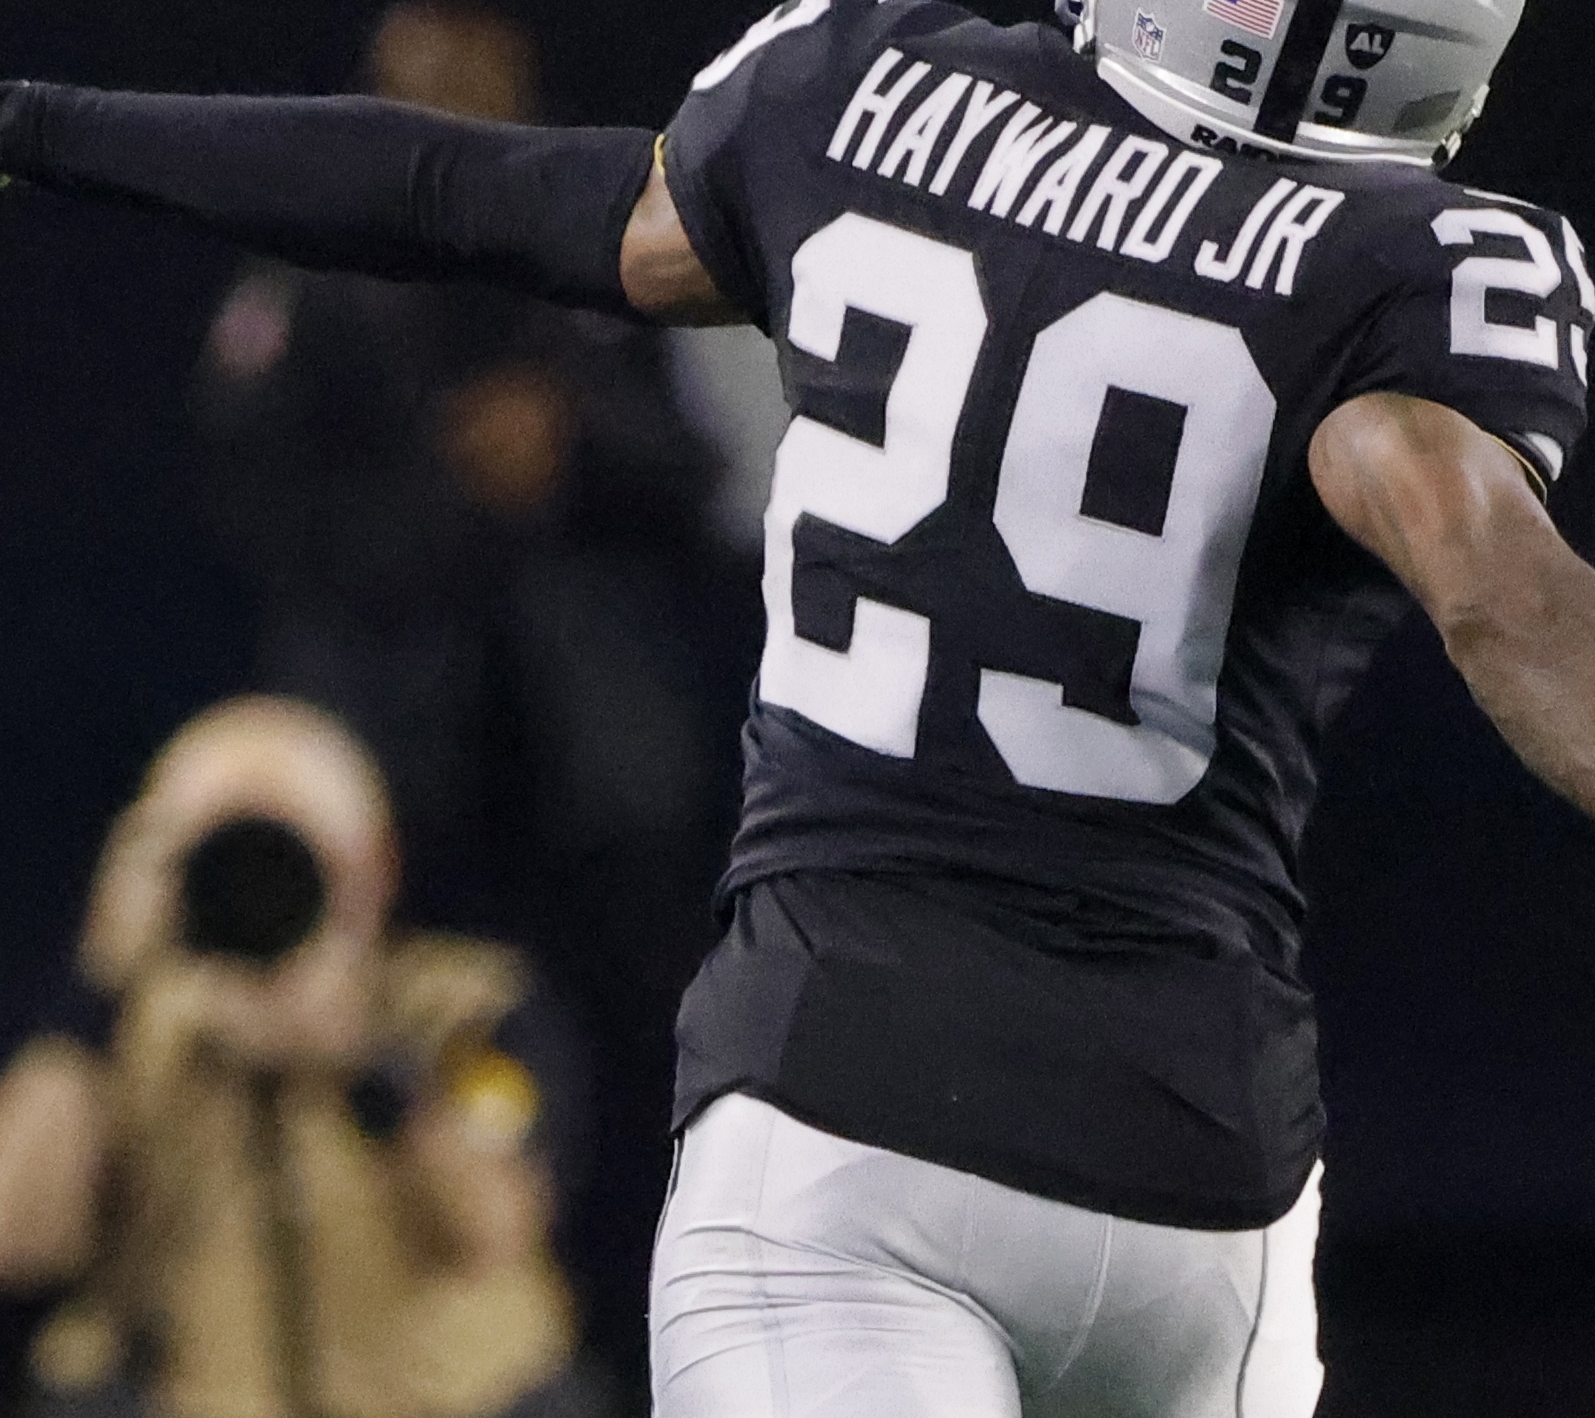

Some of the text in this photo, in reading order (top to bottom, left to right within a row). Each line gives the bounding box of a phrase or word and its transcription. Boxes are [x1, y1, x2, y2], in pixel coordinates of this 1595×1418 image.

[1350, 32, 1387, 55] AL
[826, 46, 1346, 297] HAYWARD JR
[758, 210, 1278, 806] 29
